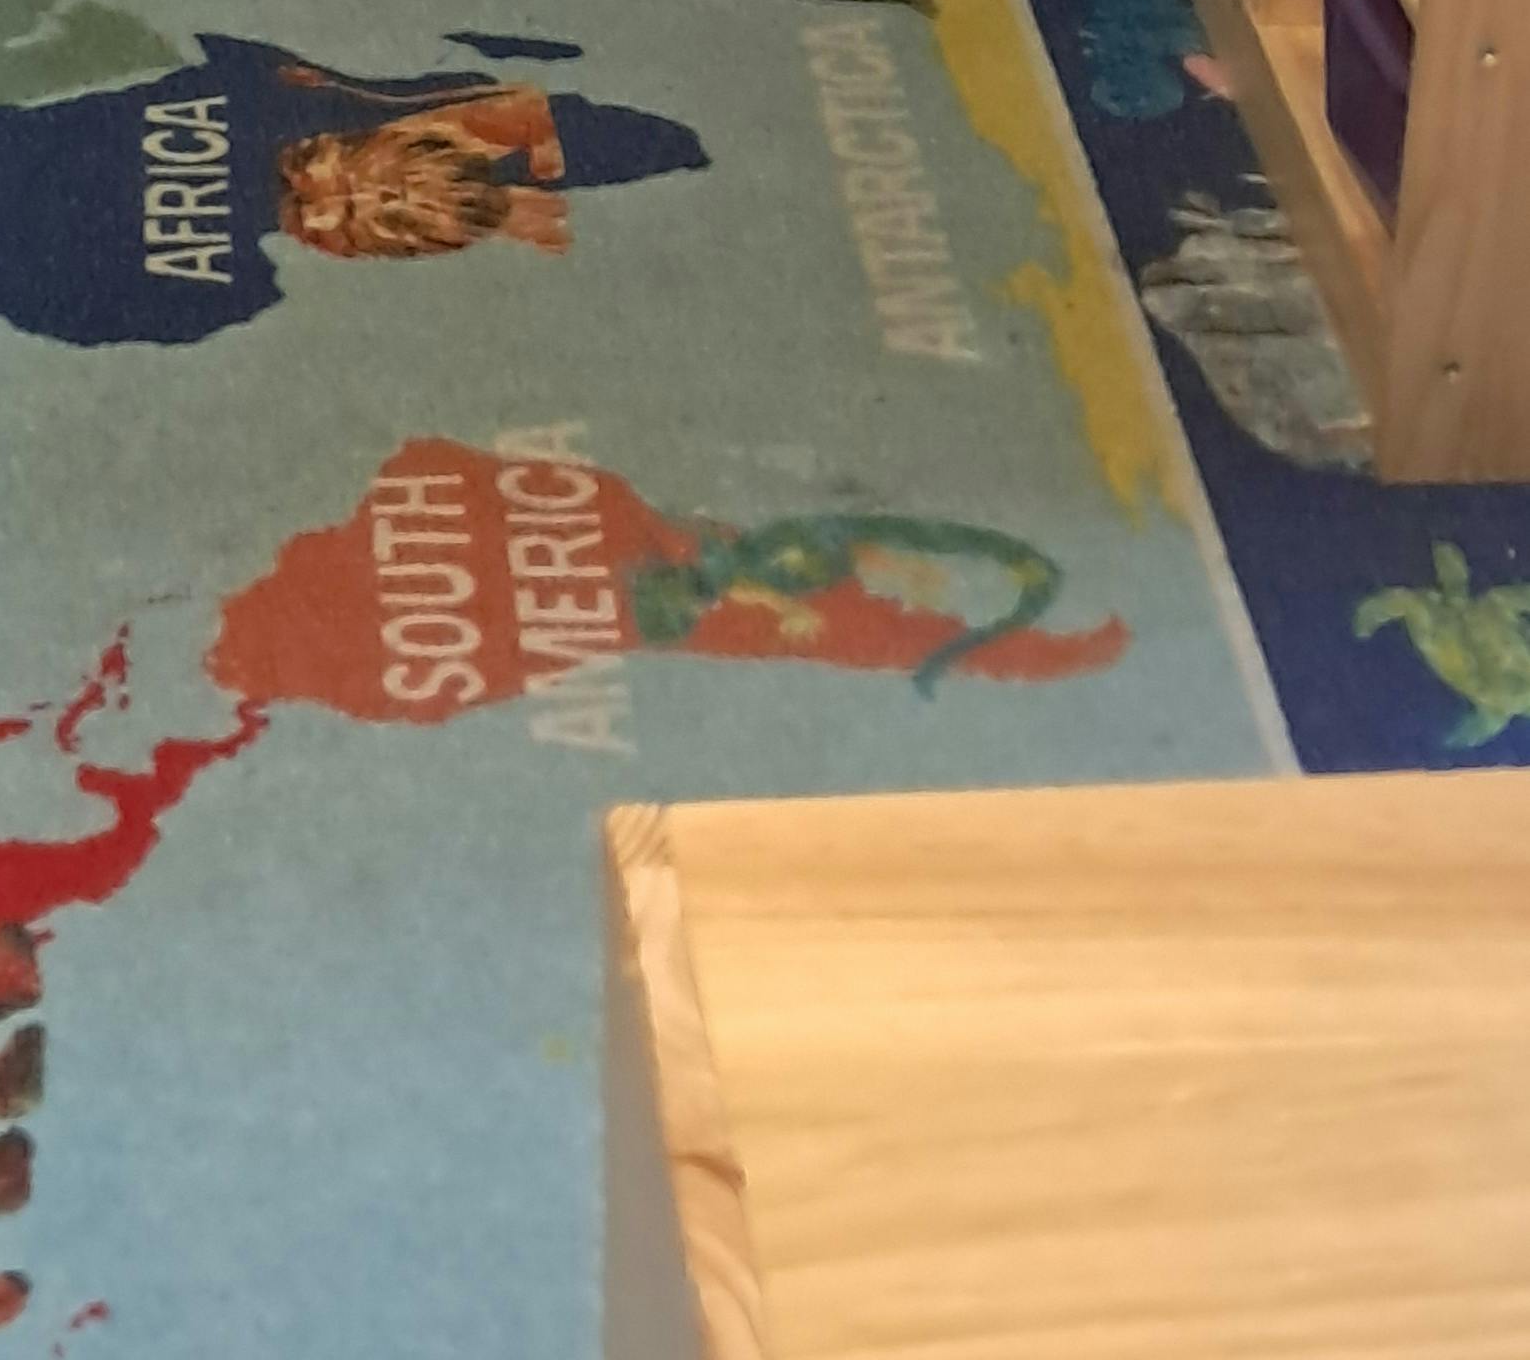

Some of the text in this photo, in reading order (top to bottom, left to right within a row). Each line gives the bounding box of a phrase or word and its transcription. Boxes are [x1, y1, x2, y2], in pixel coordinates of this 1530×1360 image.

[144, 95, 233, 284] AFRICA
[799, 19, 983, 361] ANTARCTICA
[370, 473, 485, 705] SOUTH
[494, 420, 636, 756] AMERICA
